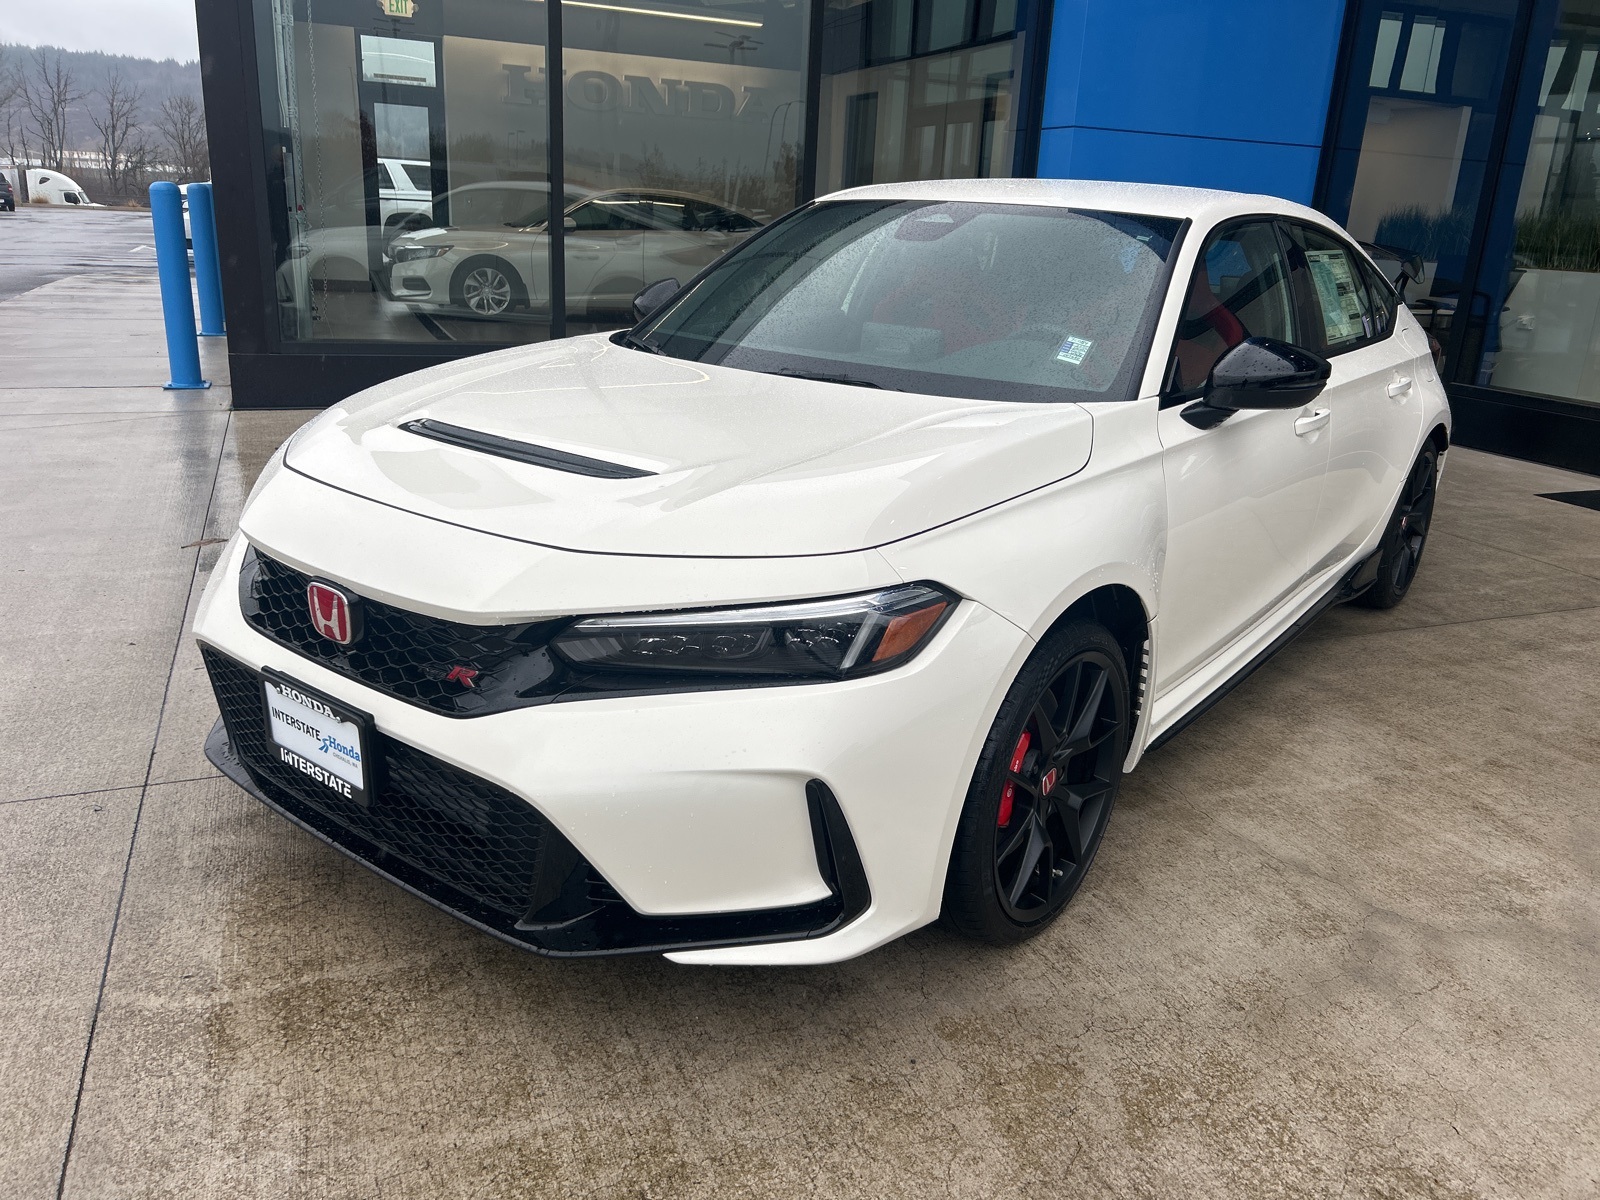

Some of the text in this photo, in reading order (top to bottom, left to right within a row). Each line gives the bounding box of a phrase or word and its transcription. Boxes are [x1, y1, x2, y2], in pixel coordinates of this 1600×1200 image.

[389, 0, 408, 14] EXIT
[502, 63, 772, 123] HONDA
[280, 683, 336, 720] HONDA
[272, 706, 361, 762] INTERSTATE Honda
[280, 747, 353, 799] INTERSTATE
